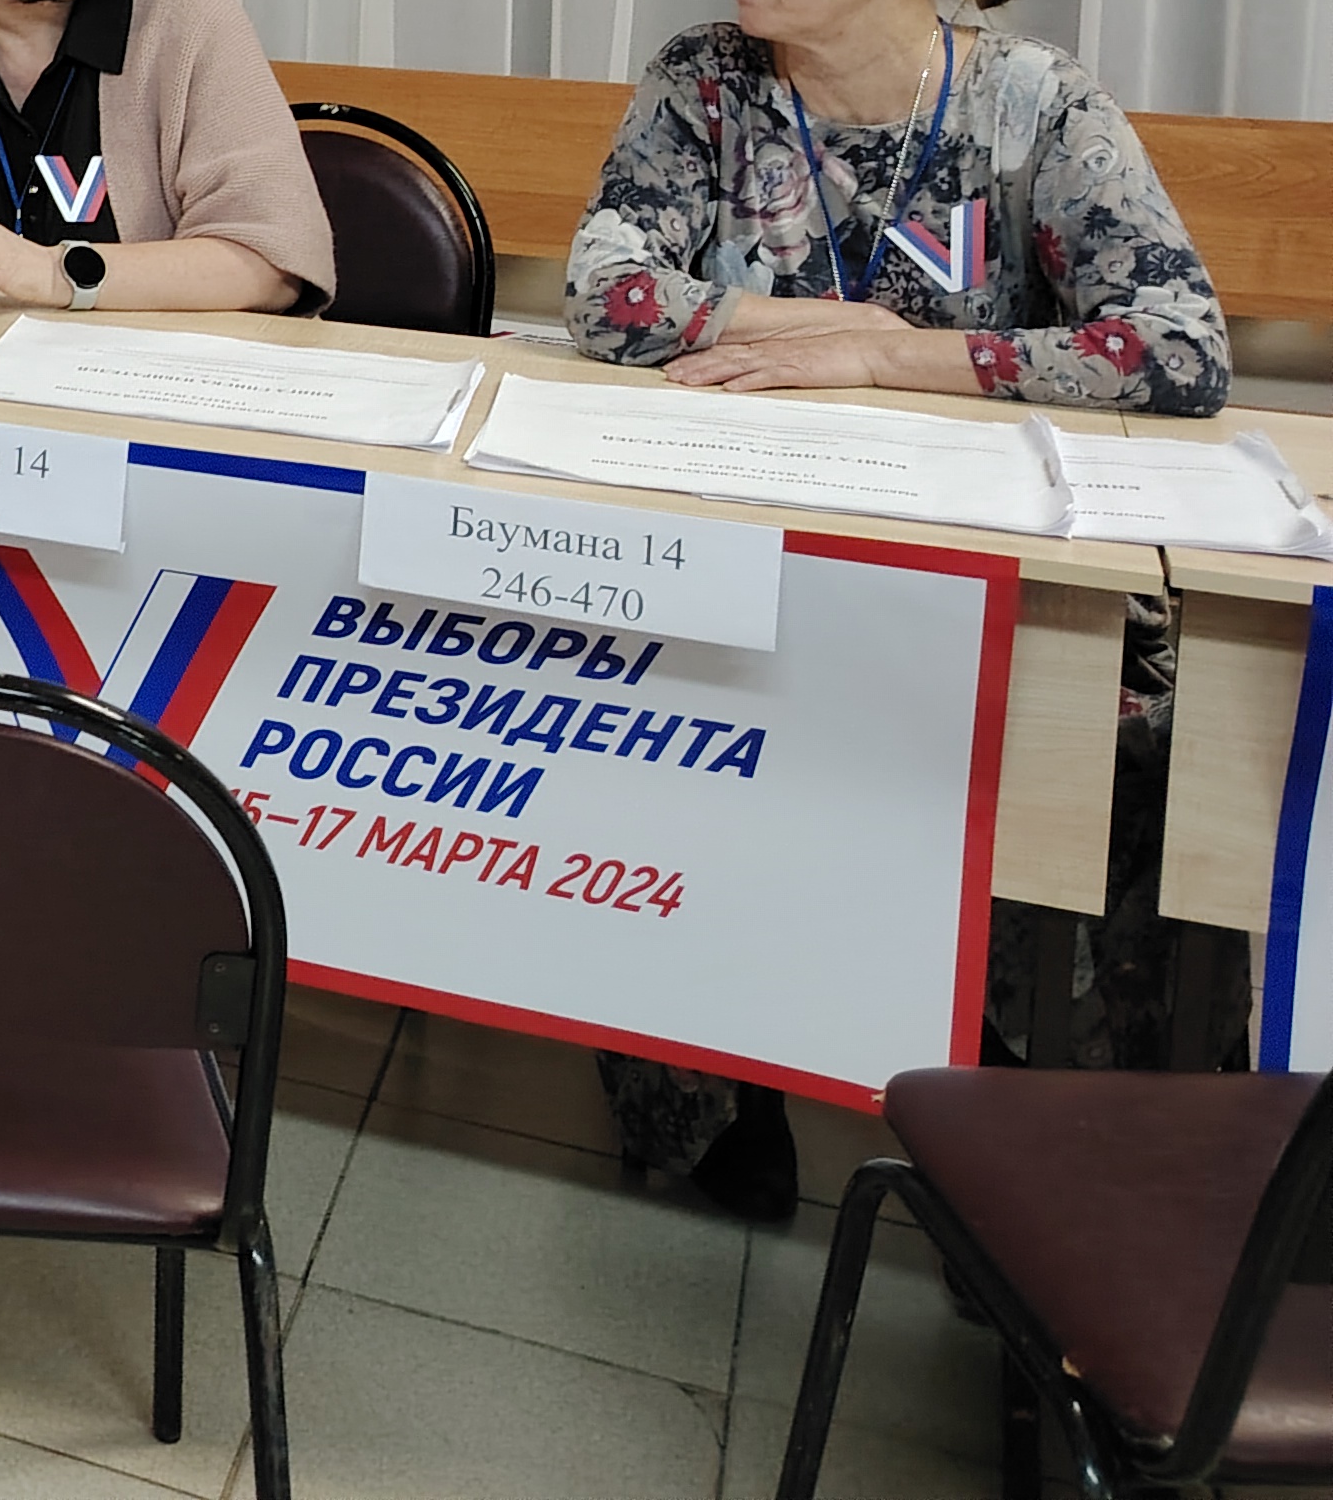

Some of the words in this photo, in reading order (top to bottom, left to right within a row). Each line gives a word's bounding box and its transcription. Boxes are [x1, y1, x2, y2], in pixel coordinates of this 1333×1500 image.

[13, 446, 50, 479] 14
[447, 504, 623, 561] Баумана
[642, 534, 686, 570] 14
[480, 566, 644, 622] 246-470
[312, 595, 665, 686] ВЫБОРЫ
[276, 654, 768, 780] ПРЕЗИДЕНТА
[239, 719, 546, 819] РОССИИ
[355, 815, 541, 892] МАРТА
[545, 852, 686, 920] 2024
